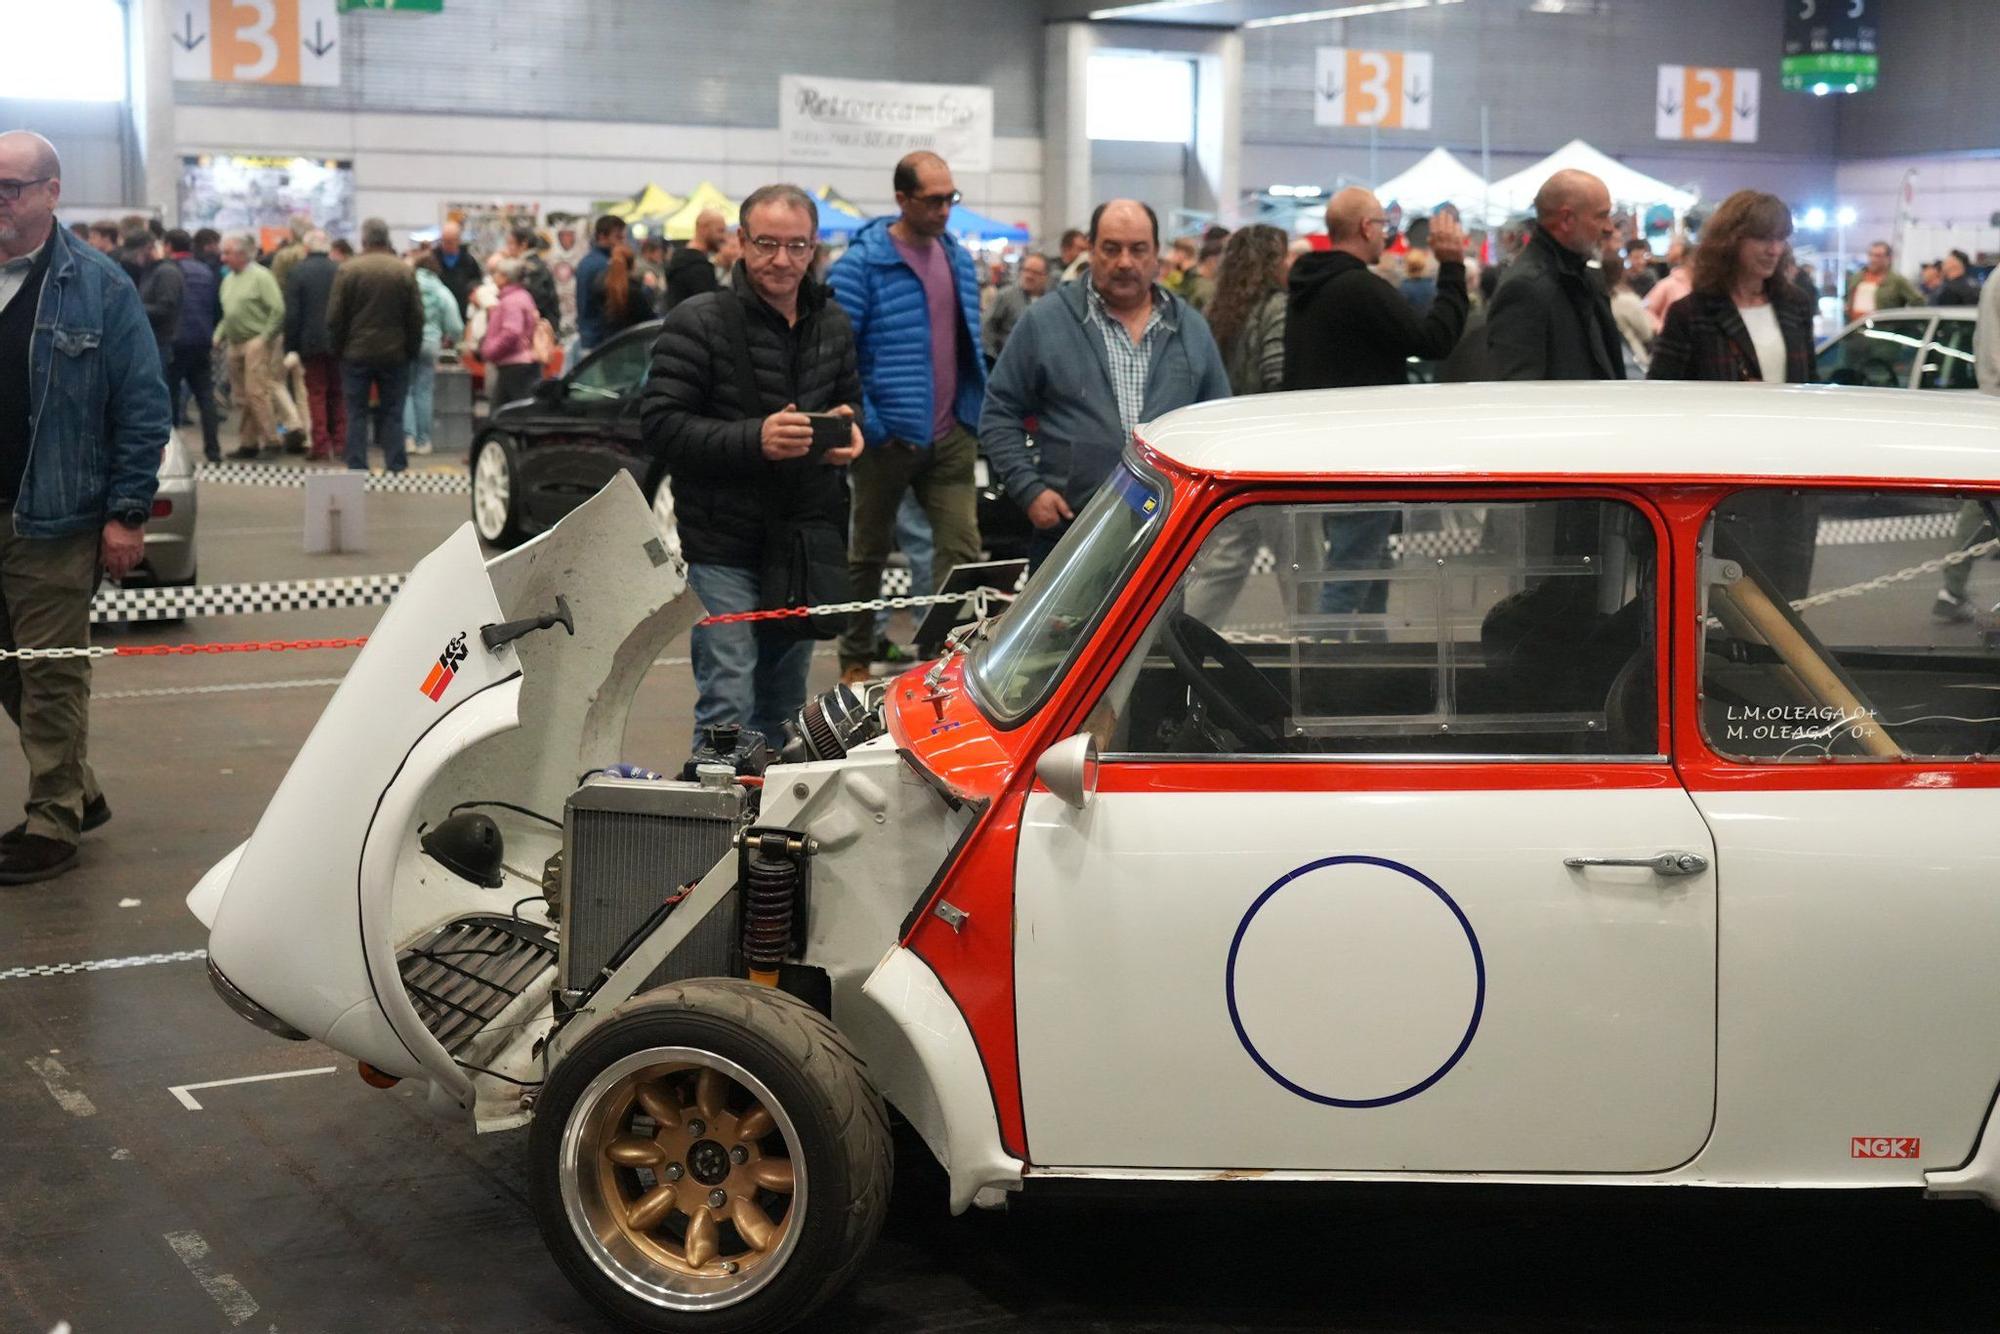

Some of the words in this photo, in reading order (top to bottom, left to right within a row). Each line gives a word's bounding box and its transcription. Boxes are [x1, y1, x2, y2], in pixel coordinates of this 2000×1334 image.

[232, 0, 279, 79] 3
[1356, 52, 1390, 126] 3
[1692, 70, 1724, 138] 3
[1752, 725, 1832, 741] OLEAGA
[1853, 1139, 1907, 1157] NGK
